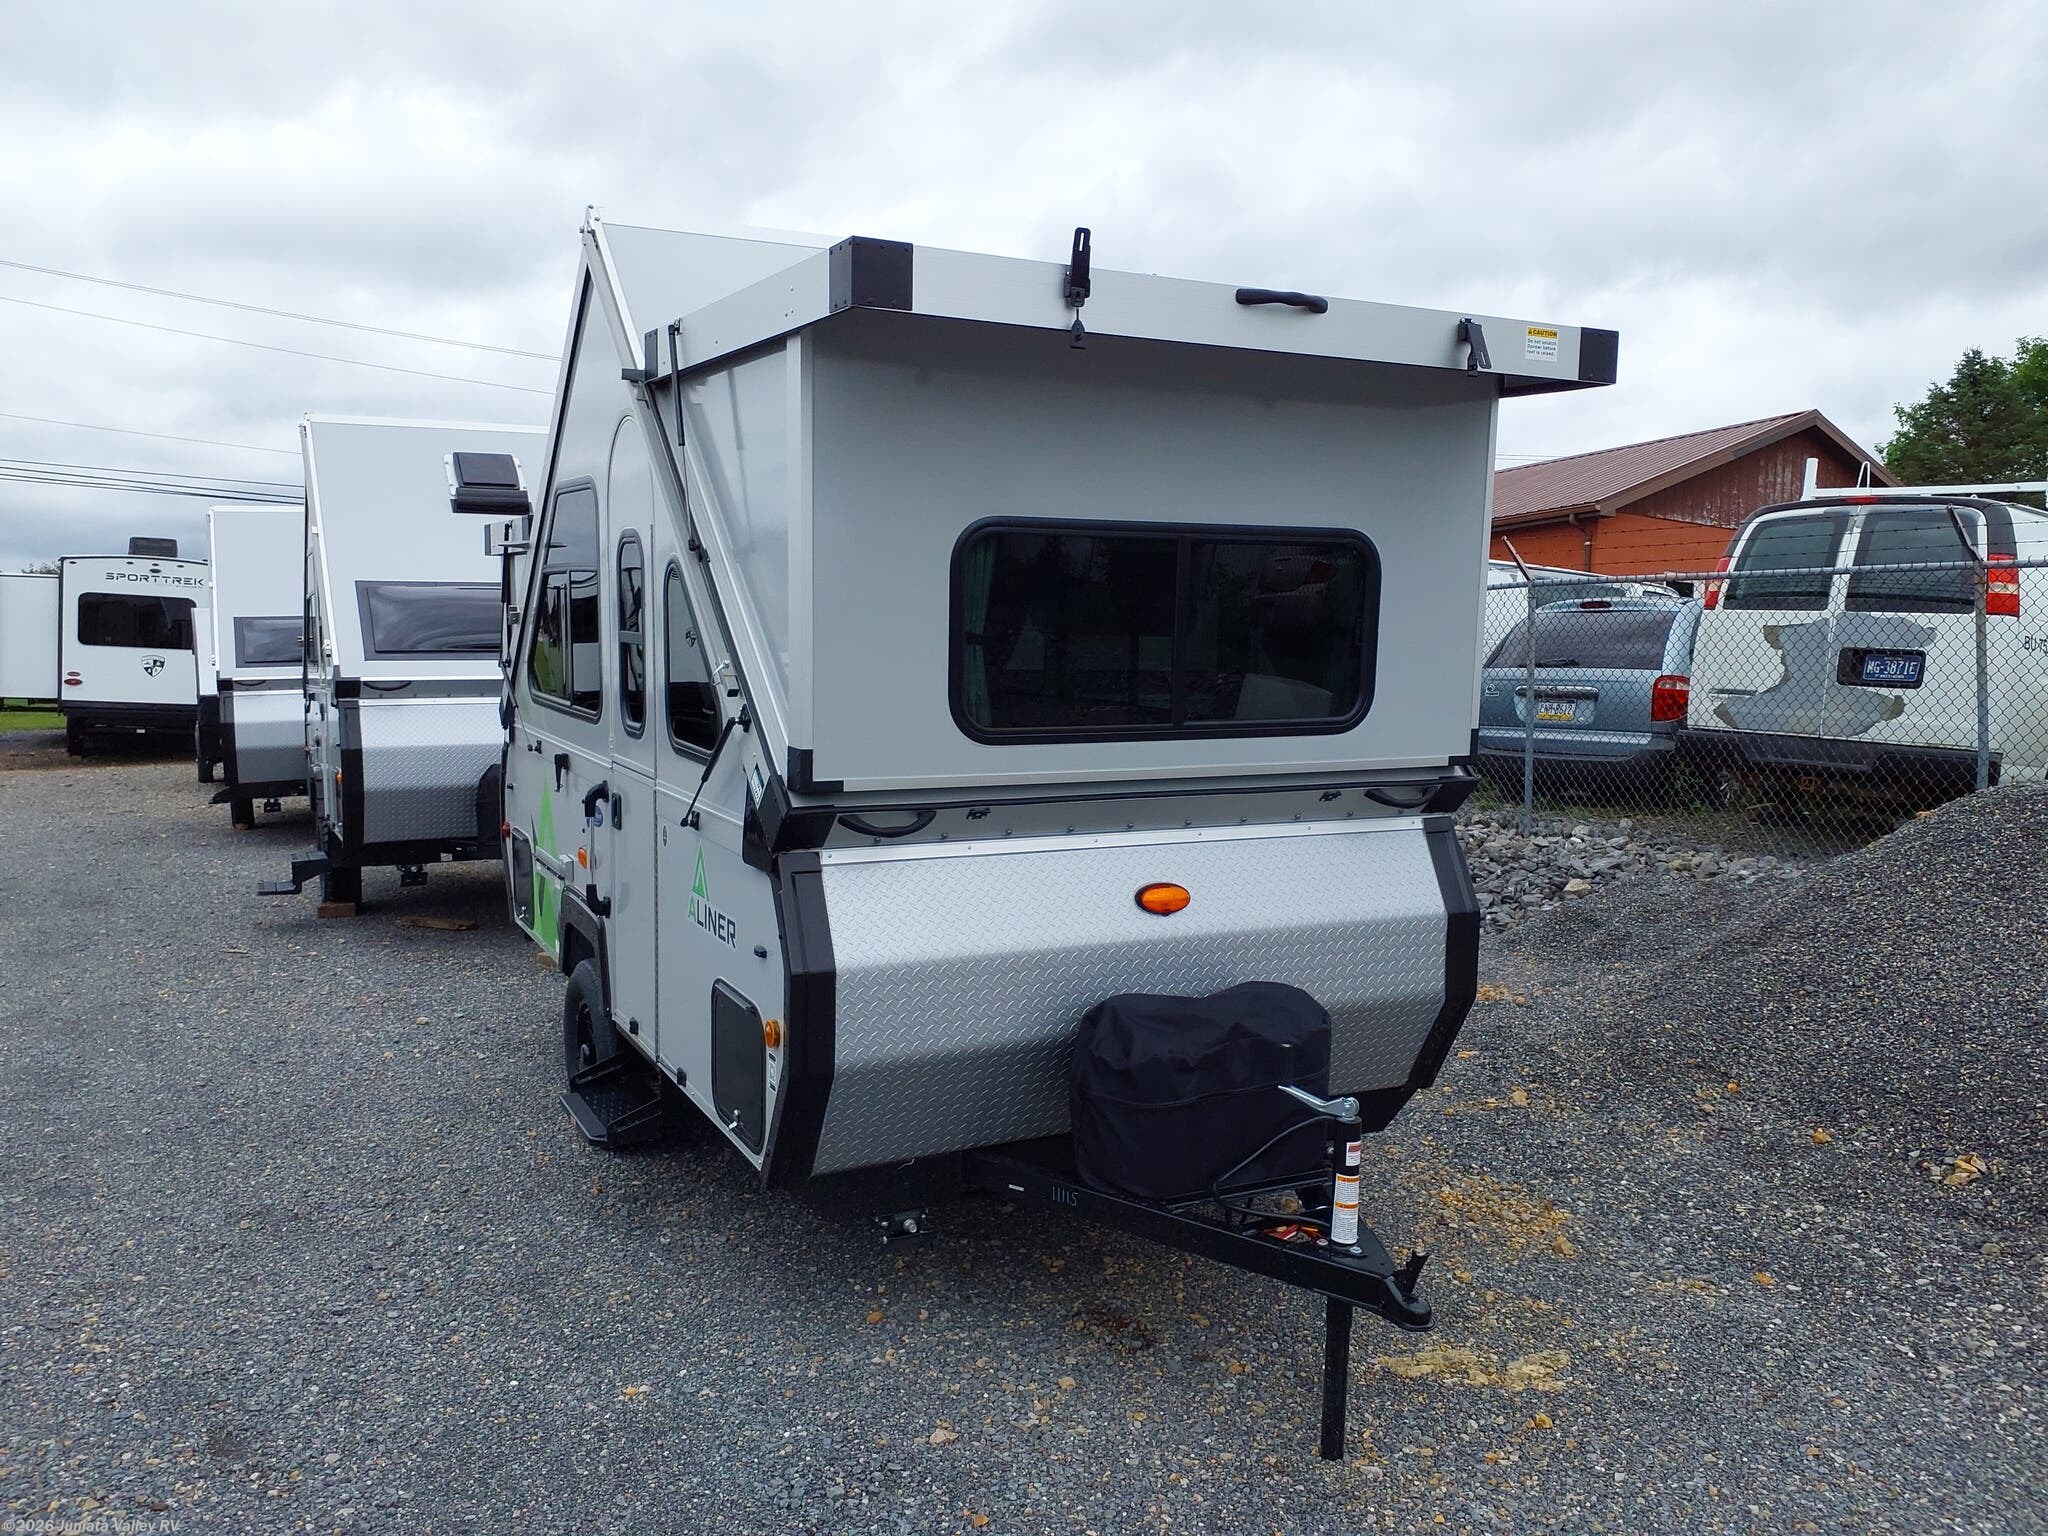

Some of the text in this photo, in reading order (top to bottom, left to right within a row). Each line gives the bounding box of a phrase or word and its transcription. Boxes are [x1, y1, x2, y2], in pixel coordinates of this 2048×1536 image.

[1533, 329, 1557, 337] CAUTION
[105, 572, 204, 586] SPORTTREK
[688, 896, 737, 949] ALINER
